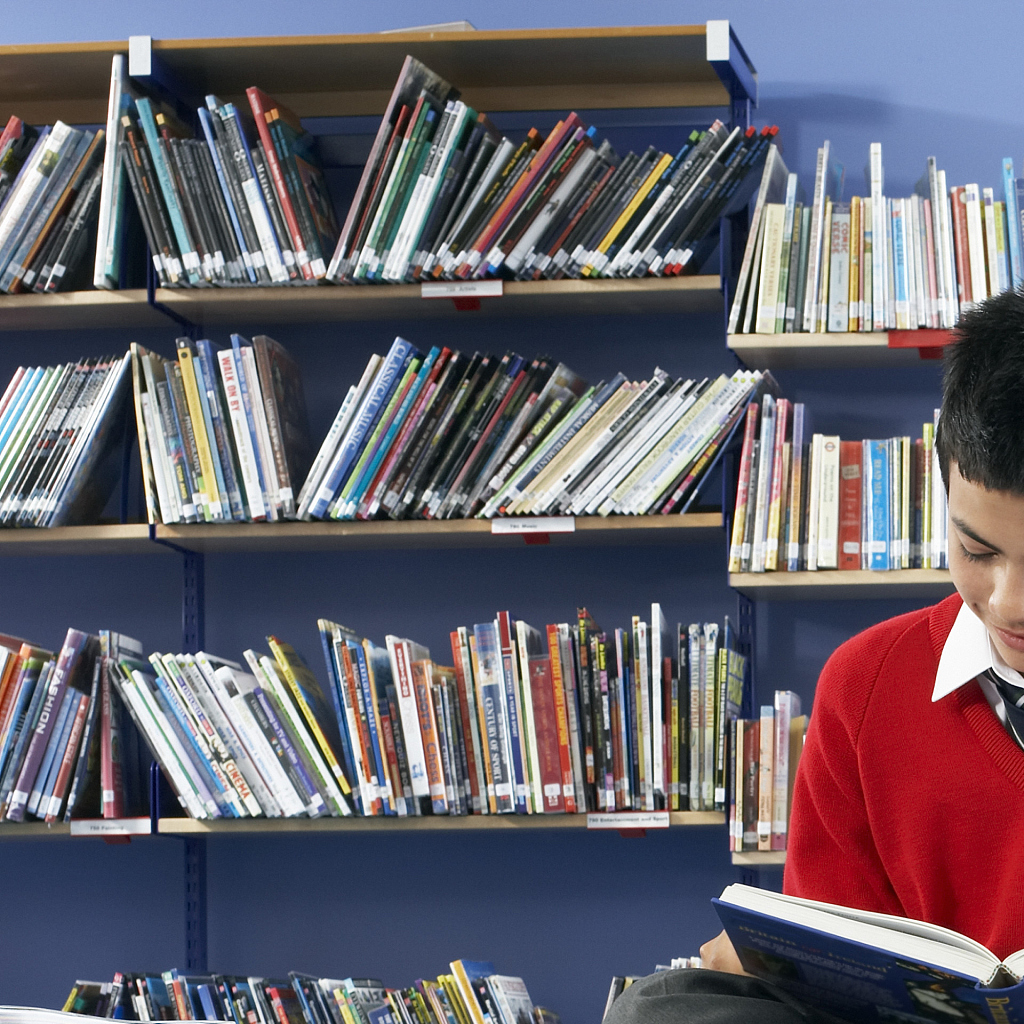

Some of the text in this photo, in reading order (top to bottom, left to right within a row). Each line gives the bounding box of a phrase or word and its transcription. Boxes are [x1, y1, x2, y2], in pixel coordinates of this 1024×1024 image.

[221, 356, 240, 412] WALK ON BY
[345, 343, 407, 451] CLASSICAL MUSIC
[531, 398, 562, 436] RAP ATTACK
[650, 400, 705, 459] GUITAR HANDBOOK
[184, 415, 201, 473] PHOTOGRAPHY
[532, 401, 600, 474] MUSICAL INSTRUMENTS
[873, 459, 881, 480] READ
[873, 482, 881, 494] ME
[550, 645, 561, 678] GREATEST
[35, 667, 63, 734] FASHION
[180, 684, 202, 716] OXFORD
[416, 684, 431, 730] IDIOT'S
[554, 679, 564, 705] SPORTS
[705, 689, 713, 728] FOOTBALL
[256, 693, 299, 764] Presenting for TV and Video
[392, 722, 406, 768] NEW QUIZ
[483, 696, 502, 781] CENTURY OF SPORT
[557, 706, 569, 745] CHAMPIONS
[224, 761, 250, 799] CINEMA
[426, 742, 440, 783] Chess
[383, 1013, 391, 1024] THE
[484, 999, 495, 1017] Martial
